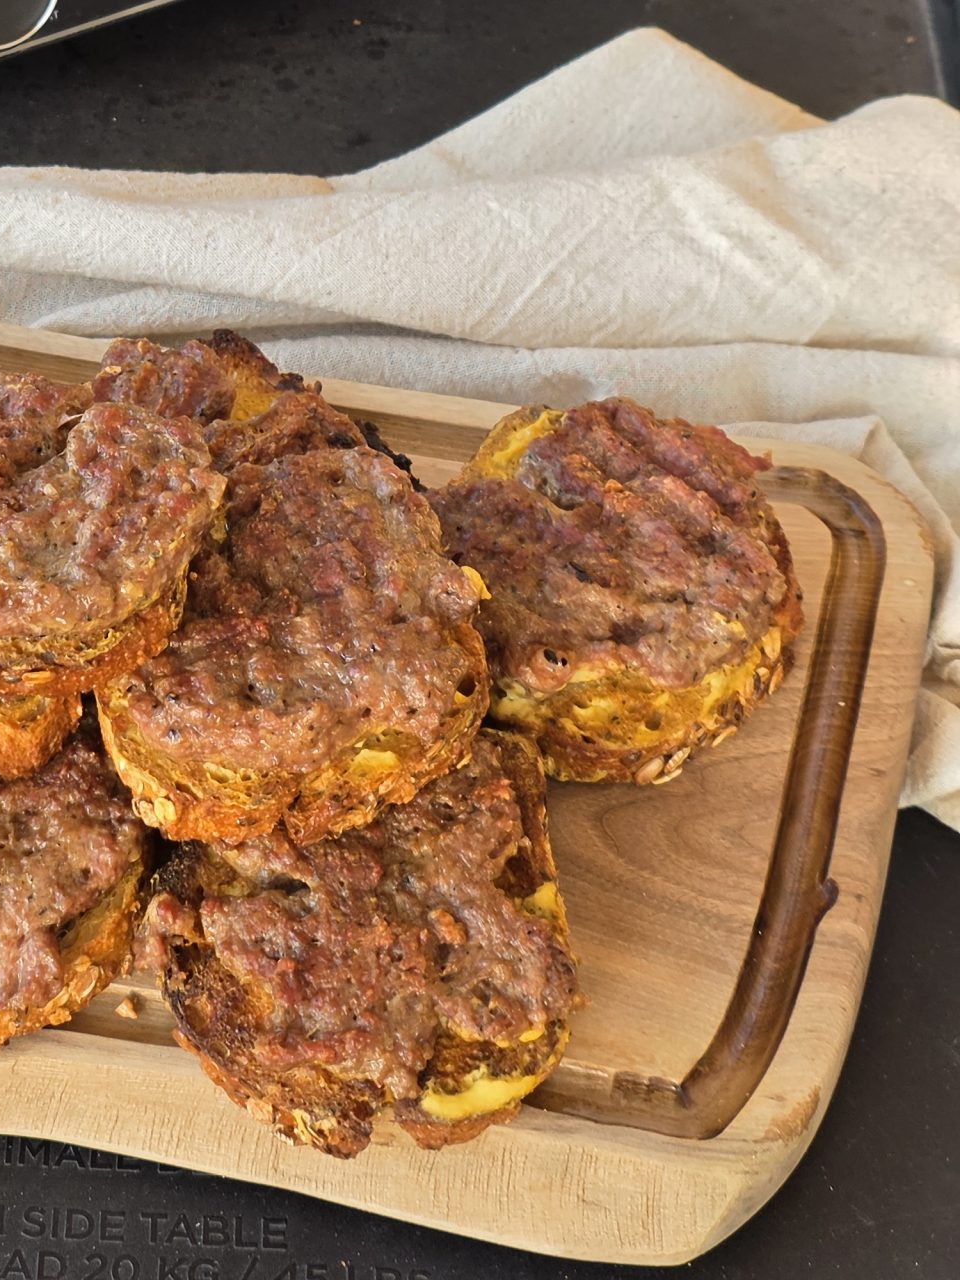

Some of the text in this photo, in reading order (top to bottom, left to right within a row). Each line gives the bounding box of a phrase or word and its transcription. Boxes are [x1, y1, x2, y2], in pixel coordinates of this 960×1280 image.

[20, 1204, 126, 1244] SIDE
[140, 1211, 289, 1252] TABLE
[84, 1253, 140, 1280] 20
